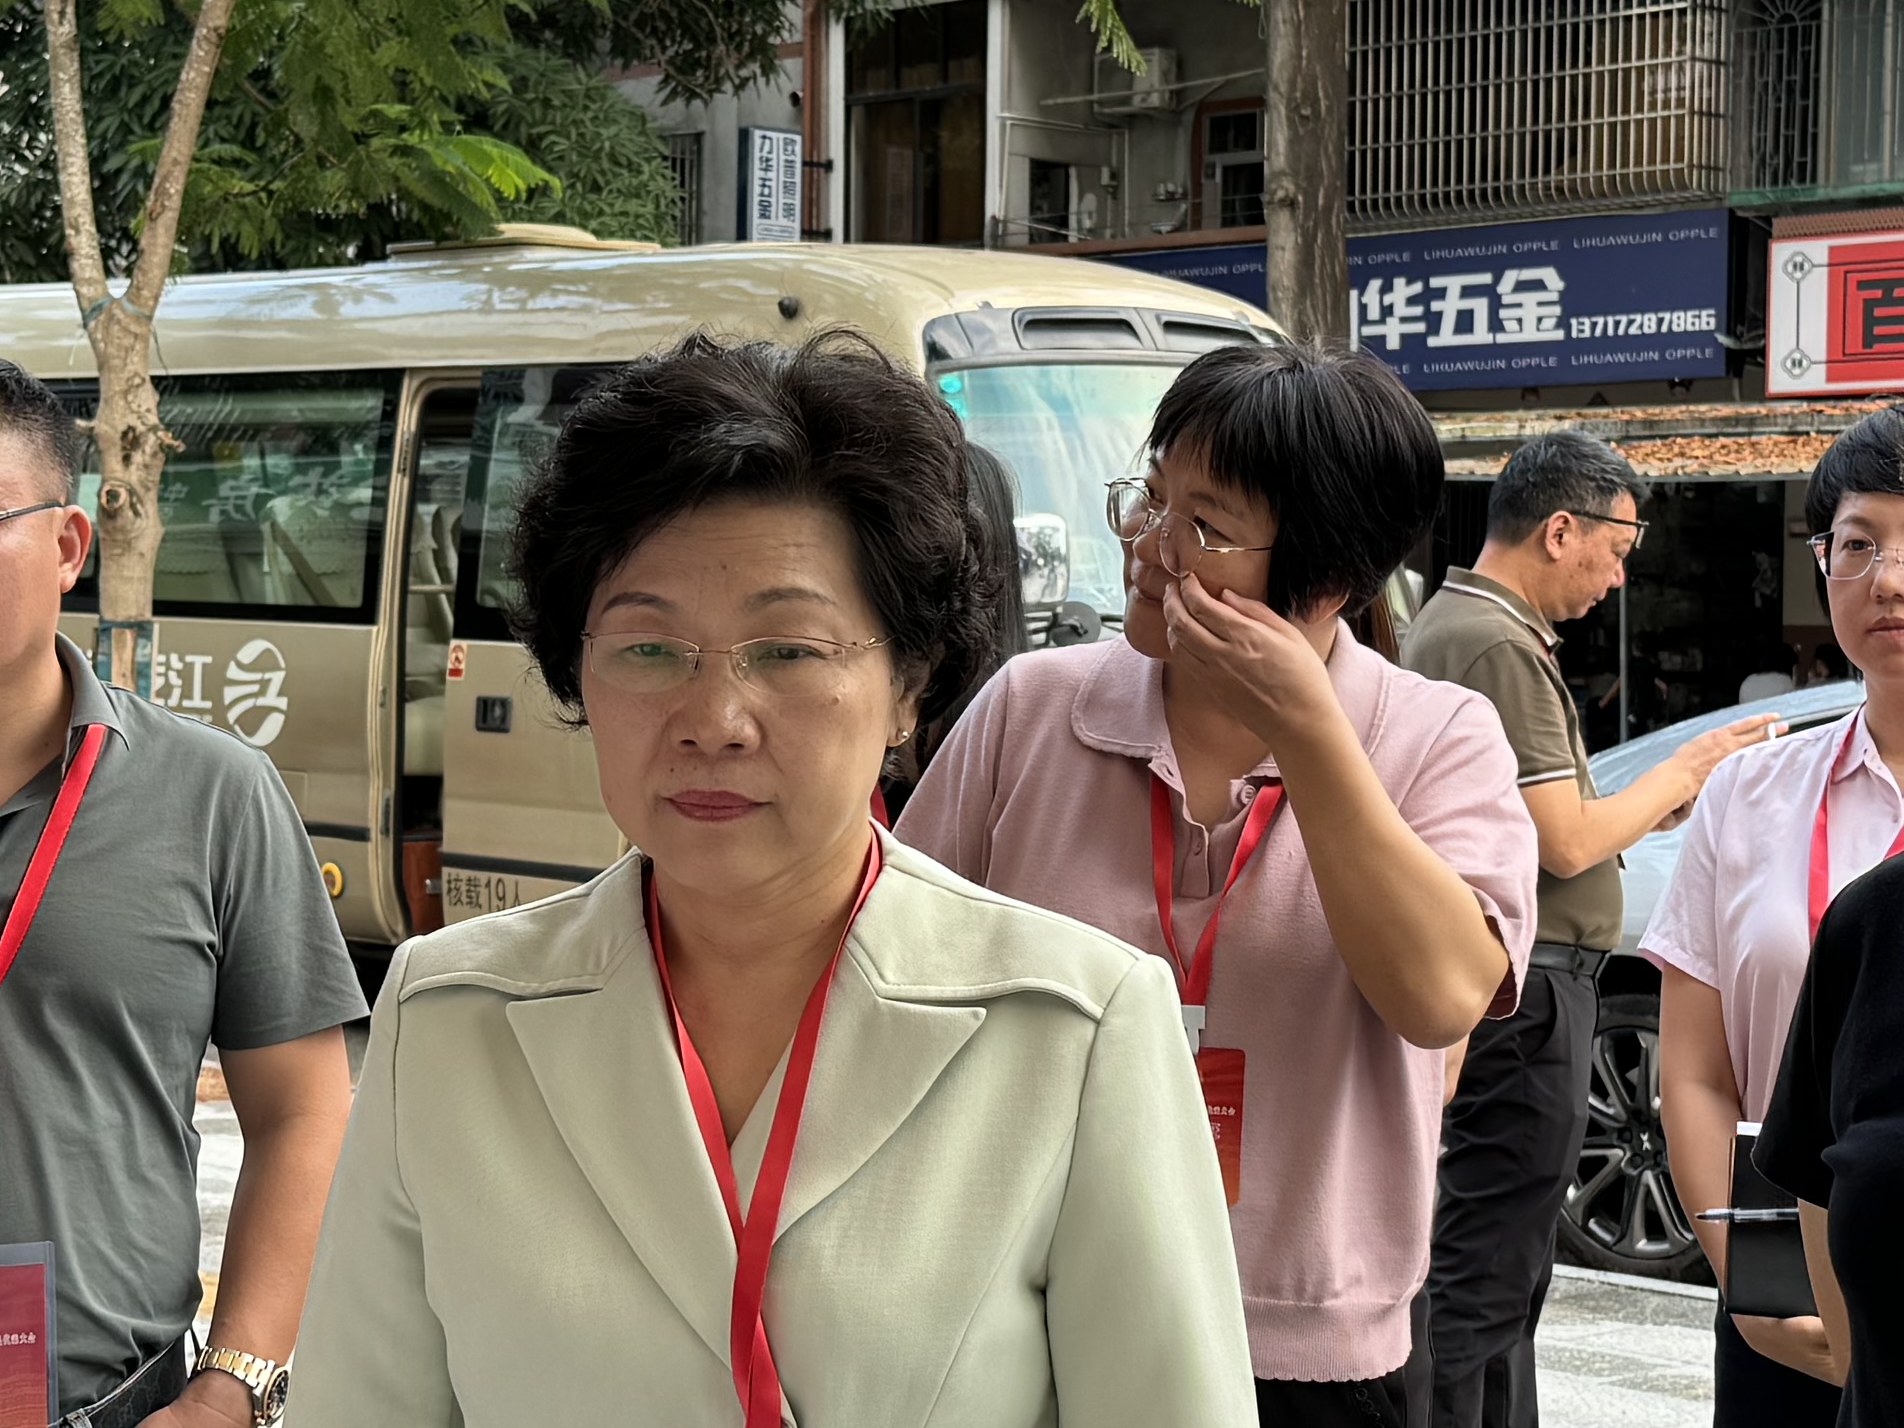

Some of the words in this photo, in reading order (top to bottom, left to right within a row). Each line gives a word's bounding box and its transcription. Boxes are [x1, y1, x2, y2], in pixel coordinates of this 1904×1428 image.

[1368, 251, 1411, 265] OPPLE
[1424, 243, 1507, 260] LIHUAWUJIN
[1513, 239, 1559, 253] OPPLE
[1573, 231, 1662, 249] LIHUAWUJIN
[1669, 226, 1719, 240] OPPLE
[1232, 261, 1266, 275] OPPL
[1570, 308, 1716, 339] 13717287866
[1424, 356, 1506, 374] LIHUAWUJIN
[1511, 355, 1558, 369] OPPLE
[1571, 350, 1659, 366] LIHUAWUJIN
[1665, 347, 1714, 361] OPPLE
